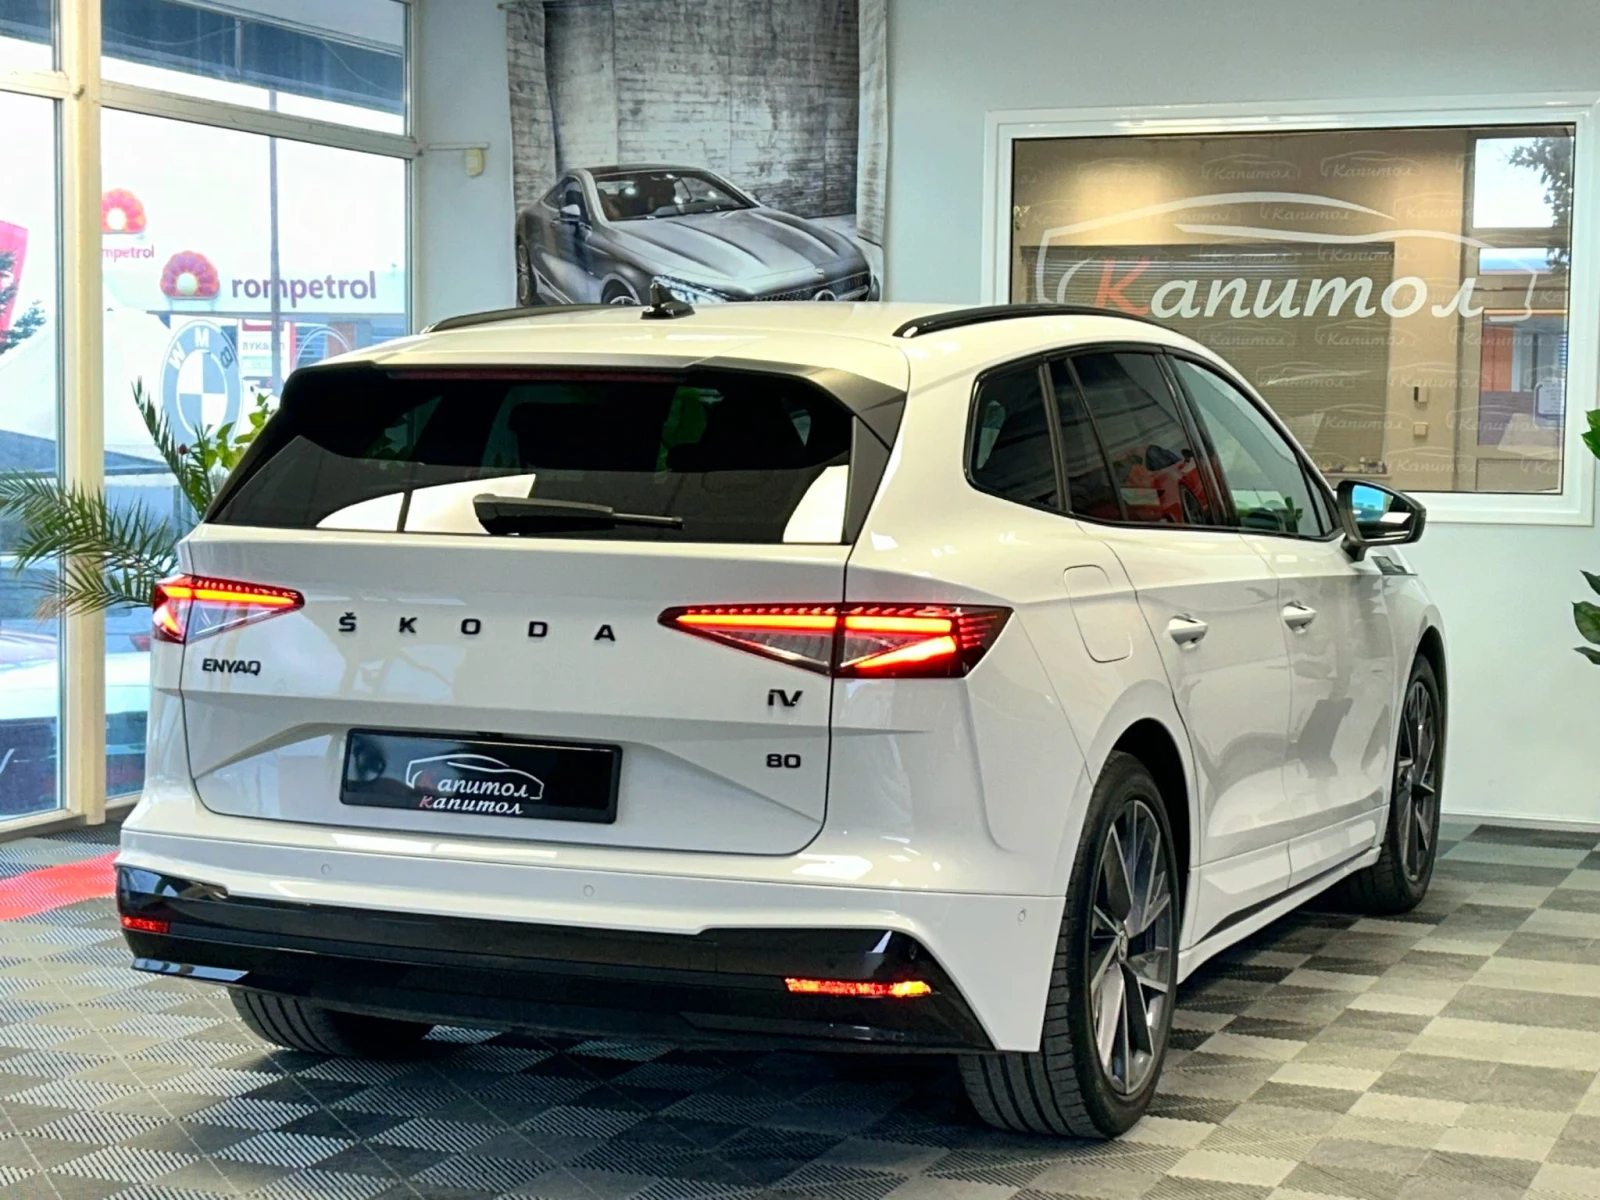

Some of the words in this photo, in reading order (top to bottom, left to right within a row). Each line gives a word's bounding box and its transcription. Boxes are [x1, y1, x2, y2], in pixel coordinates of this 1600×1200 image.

[1096, 258, 1484, 319] Капитол
[338, 612, 616, 642] ŠKODA
[202, 658, 261, 676] ENYAQ
[766, 753, 801, 769] 80
